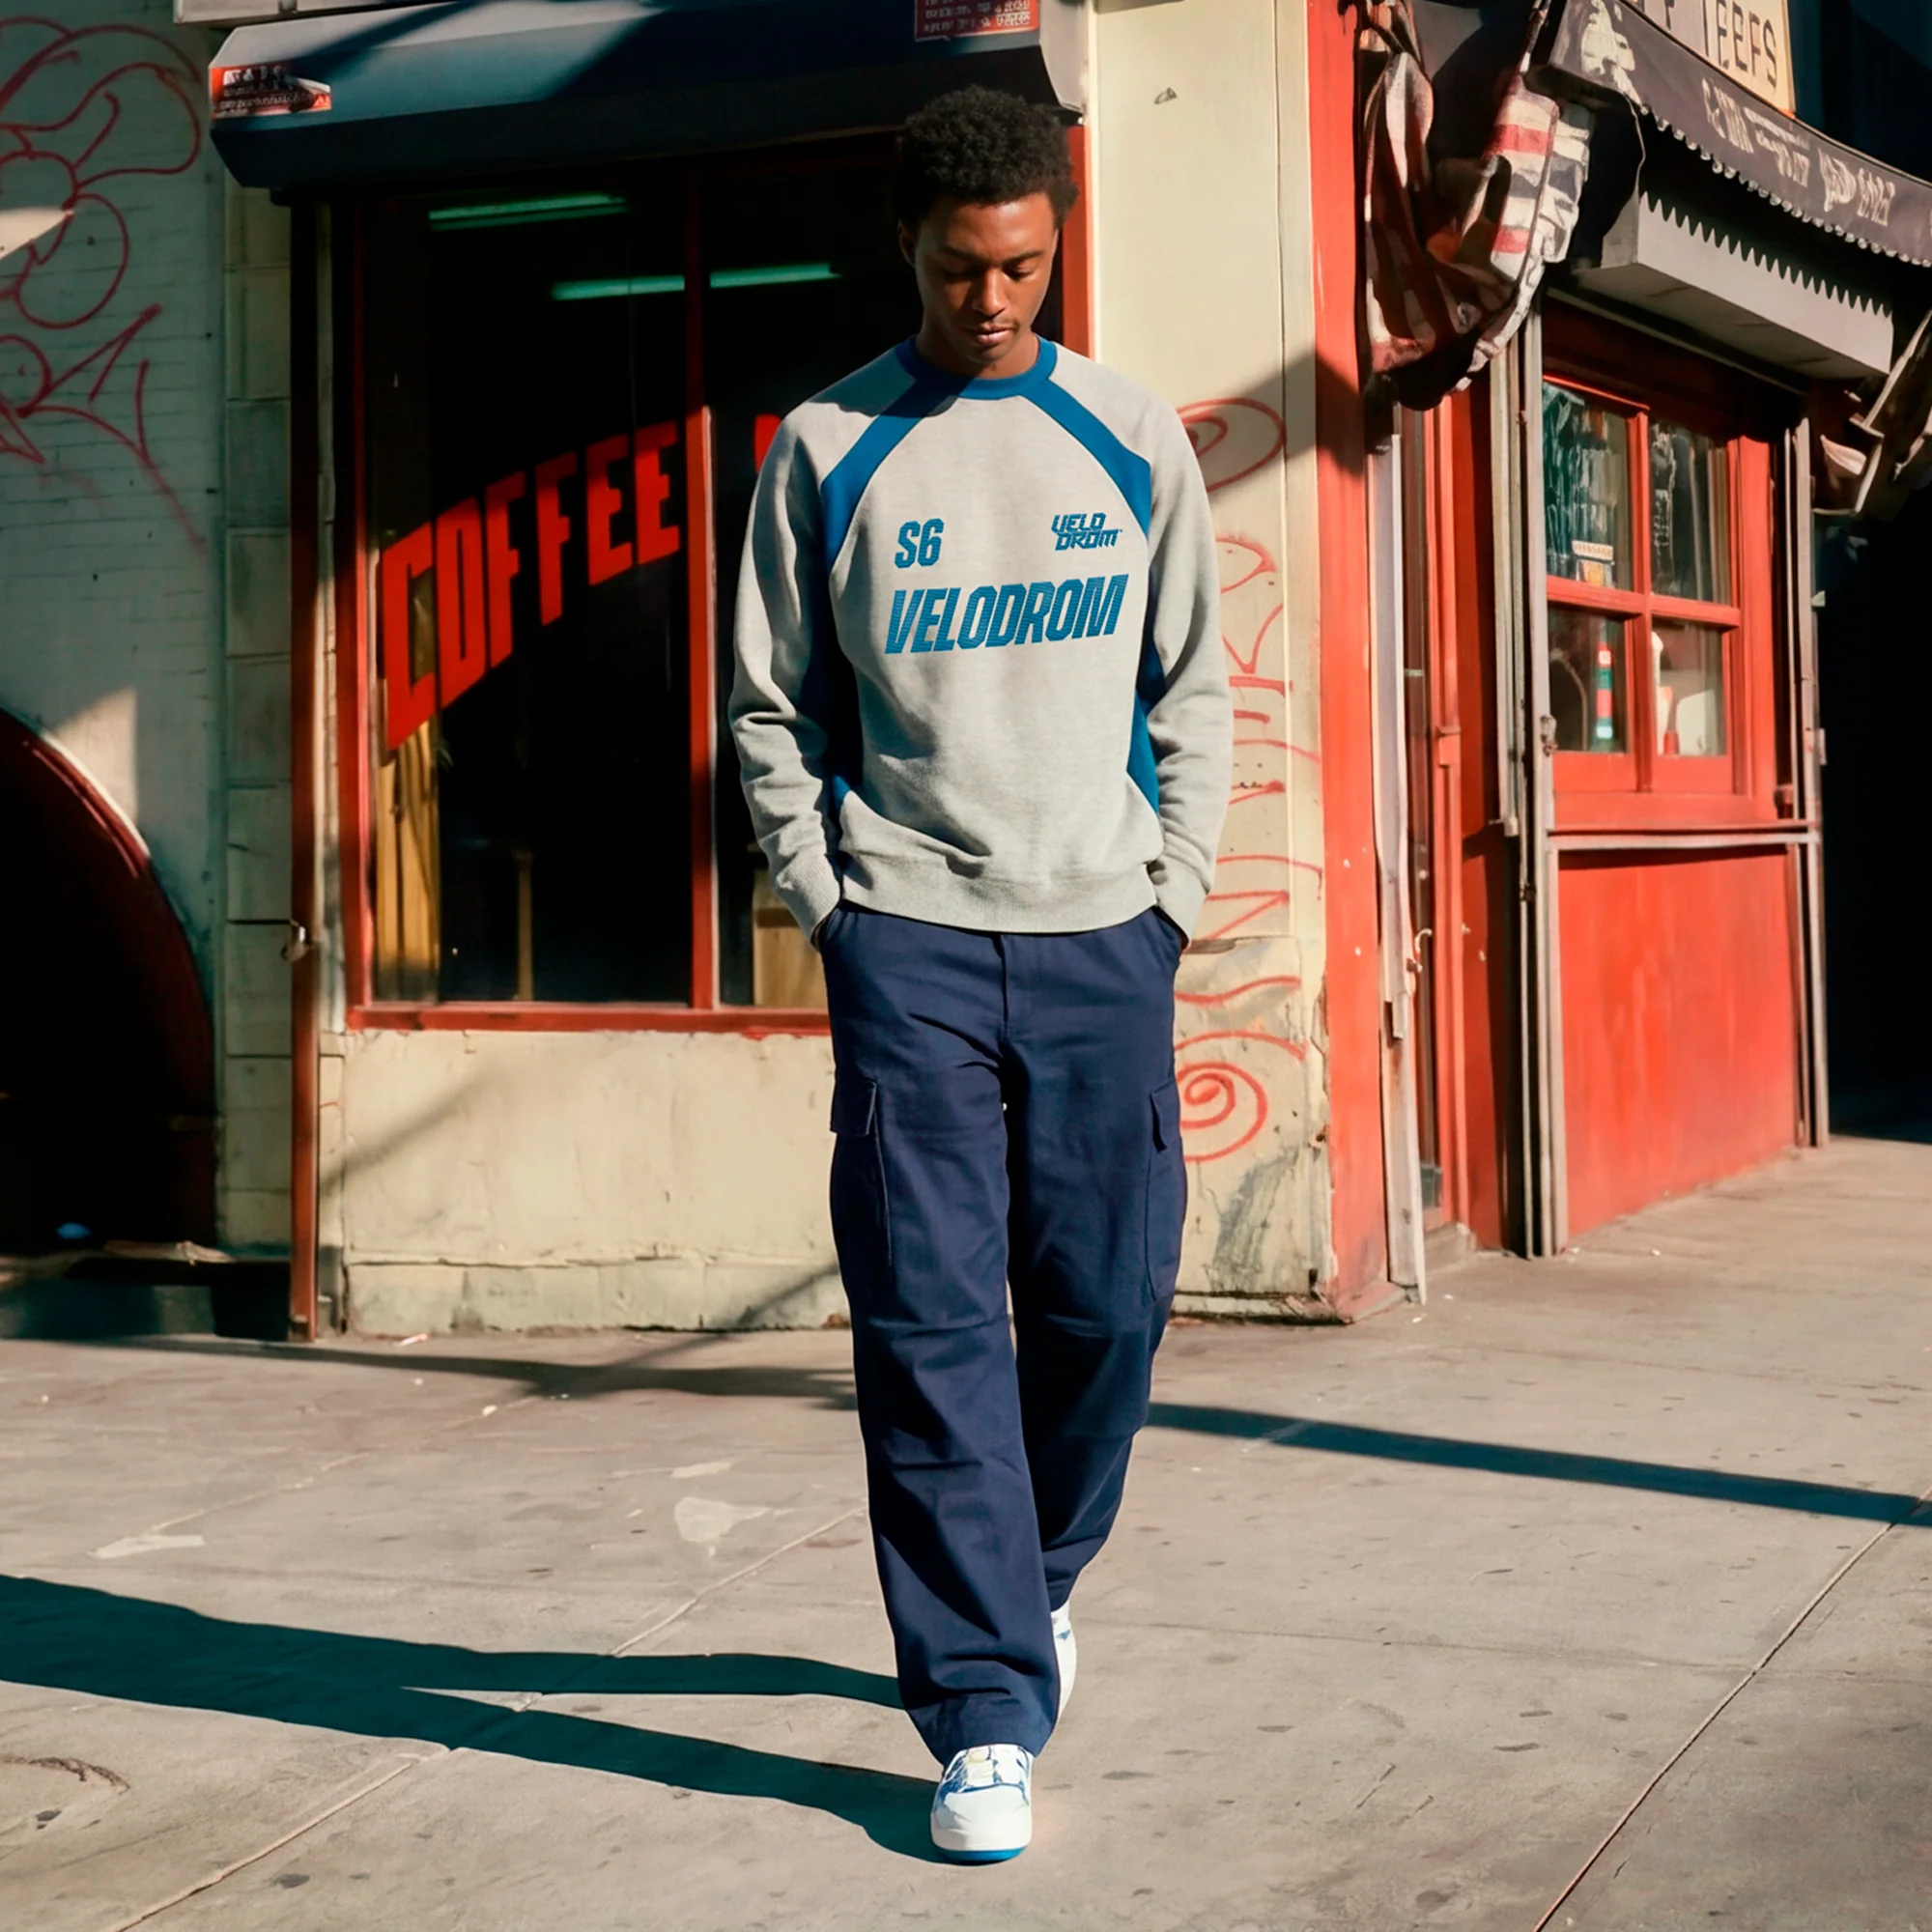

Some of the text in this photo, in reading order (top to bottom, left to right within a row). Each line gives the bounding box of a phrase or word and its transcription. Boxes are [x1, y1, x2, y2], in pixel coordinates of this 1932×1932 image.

[895, 518, 945, 569] S6
[382, 420, 680, 752] COFFEE
[884, 573, 1129, 654] VELODROM
